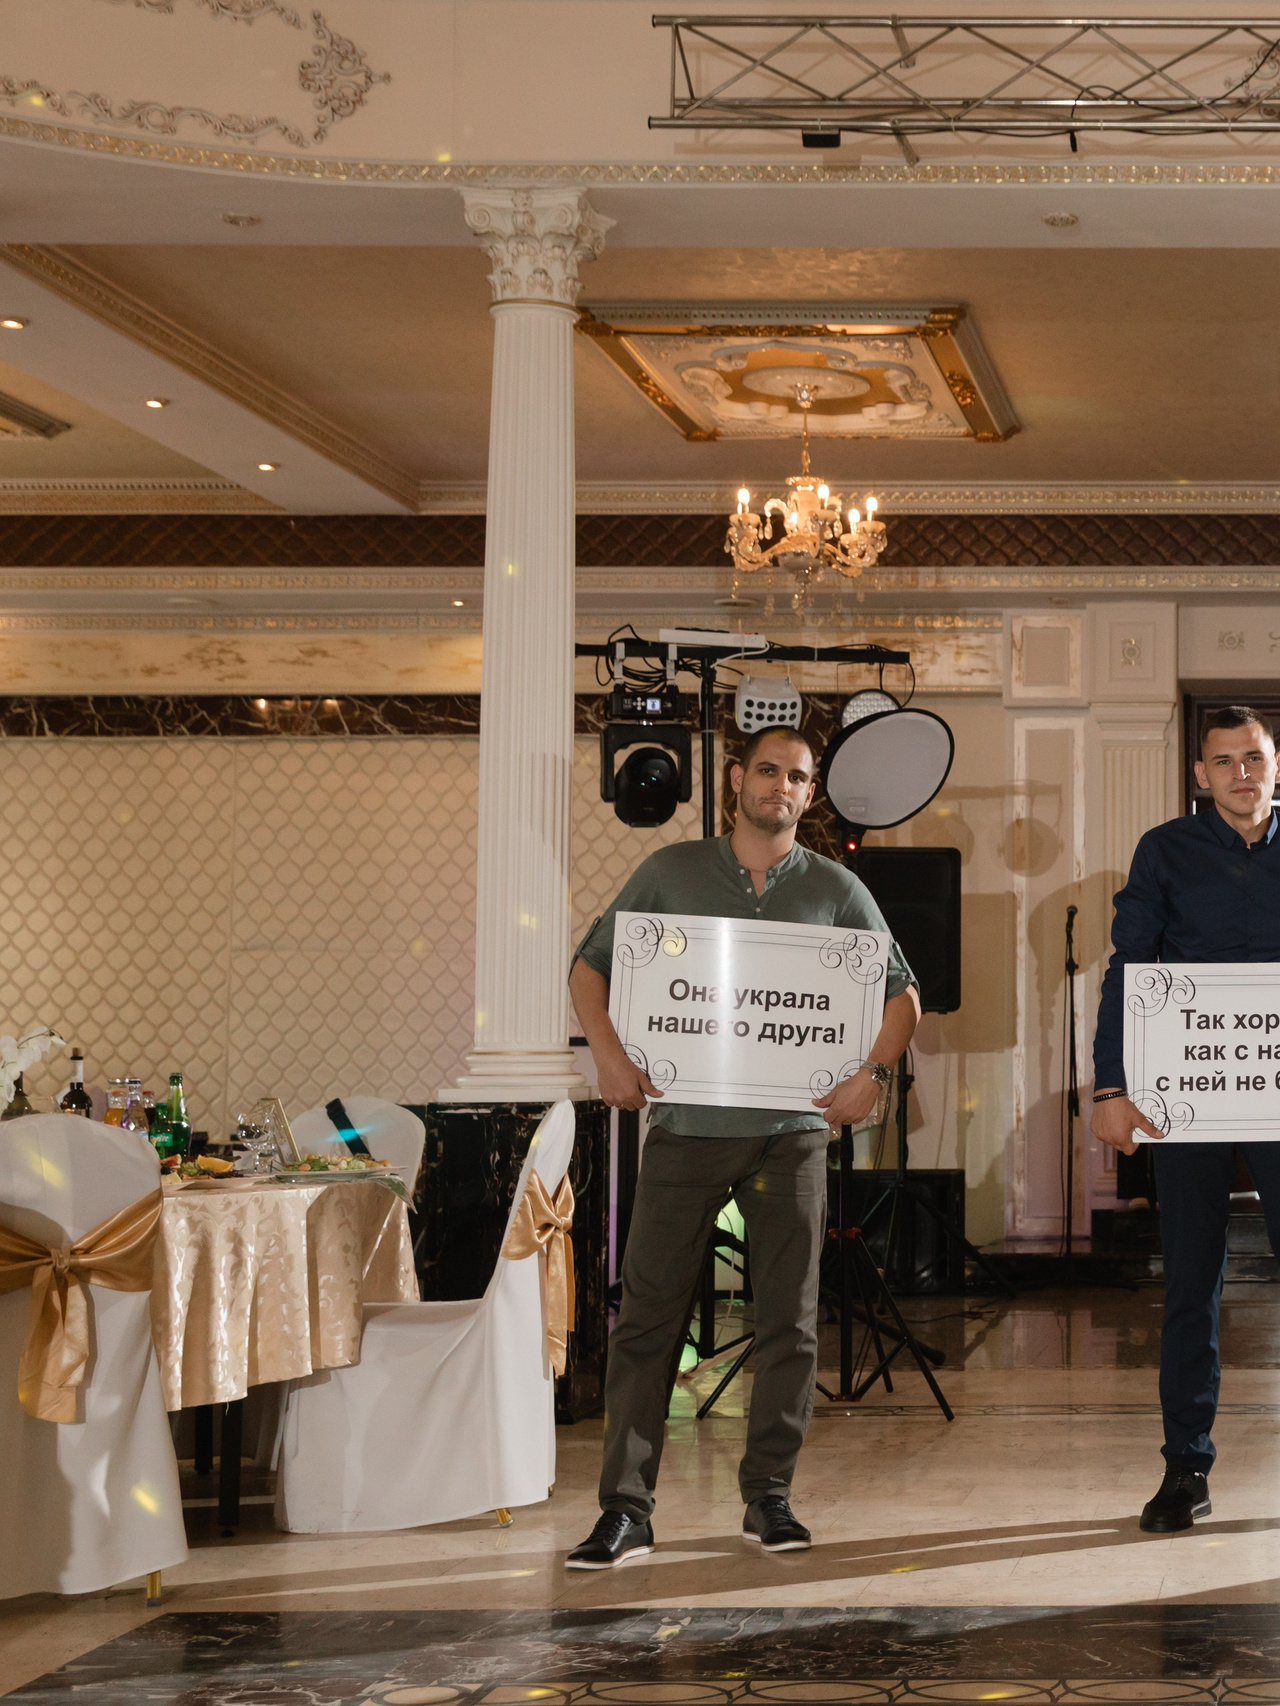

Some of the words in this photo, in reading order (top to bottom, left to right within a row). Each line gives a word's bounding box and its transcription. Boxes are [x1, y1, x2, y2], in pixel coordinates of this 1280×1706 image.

[668, 978, 722, 1003] Она
[733, 987, 831, 1012] украла
[1180, 1008, 1226, 1030] Так
[647, 1015, 751, 1038] нашео
[757, 1021, 846, 1048] друга!
[1184, 1044, 1227, 1061] как
[1234, 1044, 1249, 1061] с
[1155, 1075, 1170, 1092] с
[1179, 1070, 1226, 1092] ней
[1236, 1075, 1266, 1091] не
